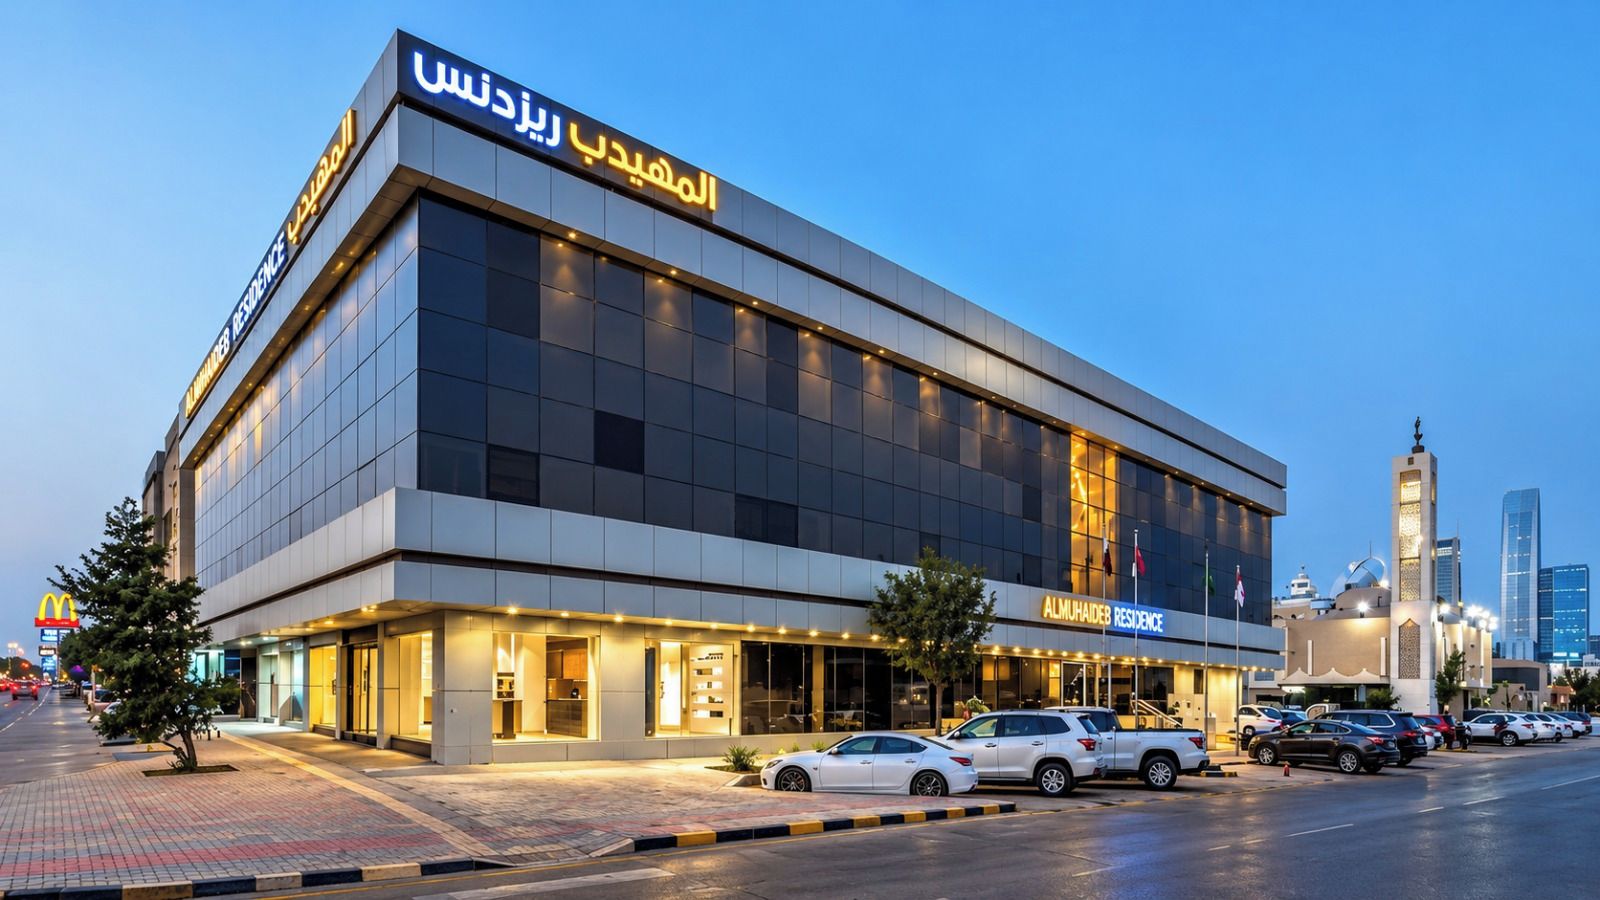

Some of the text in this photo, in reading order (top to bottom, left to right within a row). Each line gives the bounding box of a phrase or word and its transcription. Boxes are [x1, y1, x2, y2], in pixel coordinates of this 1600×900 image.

[287, 108, 357, 246] المهيدب
[412, 50, 717, 211] المهيدب ريزدنس
[231, 231, 286, 340] RESIDENCE
[1042, 594, 1164, 633] ALMUHAIDEB RESIDENCE
